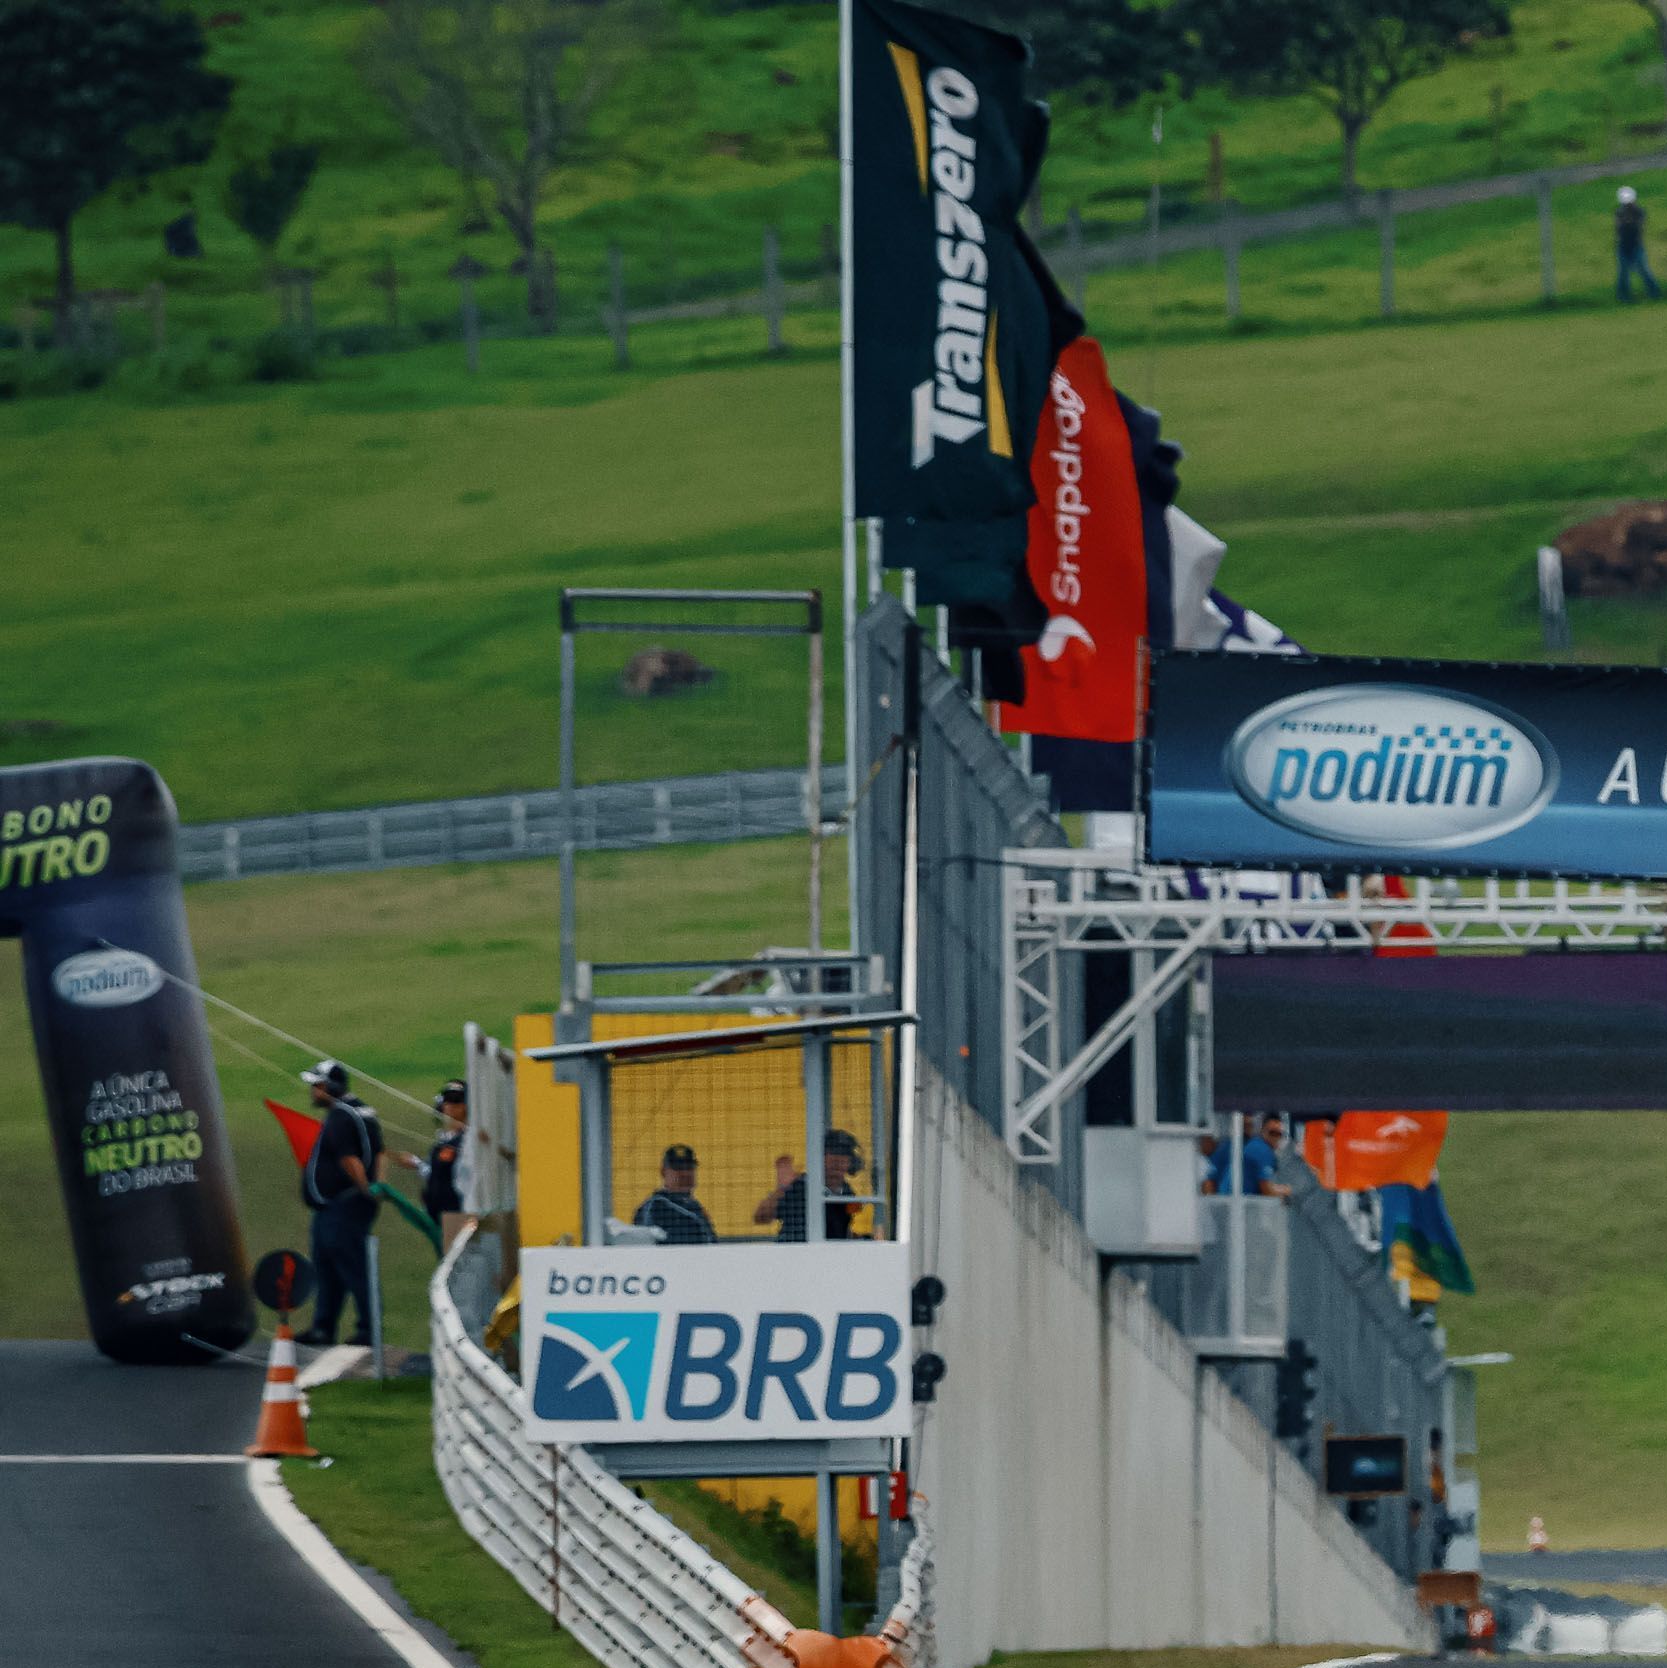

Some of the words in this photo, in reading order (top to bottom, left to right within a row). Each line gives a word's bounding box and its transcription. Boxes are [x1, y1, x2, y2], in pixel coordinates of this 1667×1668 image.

[911, 66, 984, 469] Transzero
[1266, 732, 1511, 808] podium
[1599, 745, 1641, 805] A
[84, 1131, 203, 1175] NEUTRO
[548, 1268, 668, 1297] banco
[665, 1312, 901, 1421] BRB
